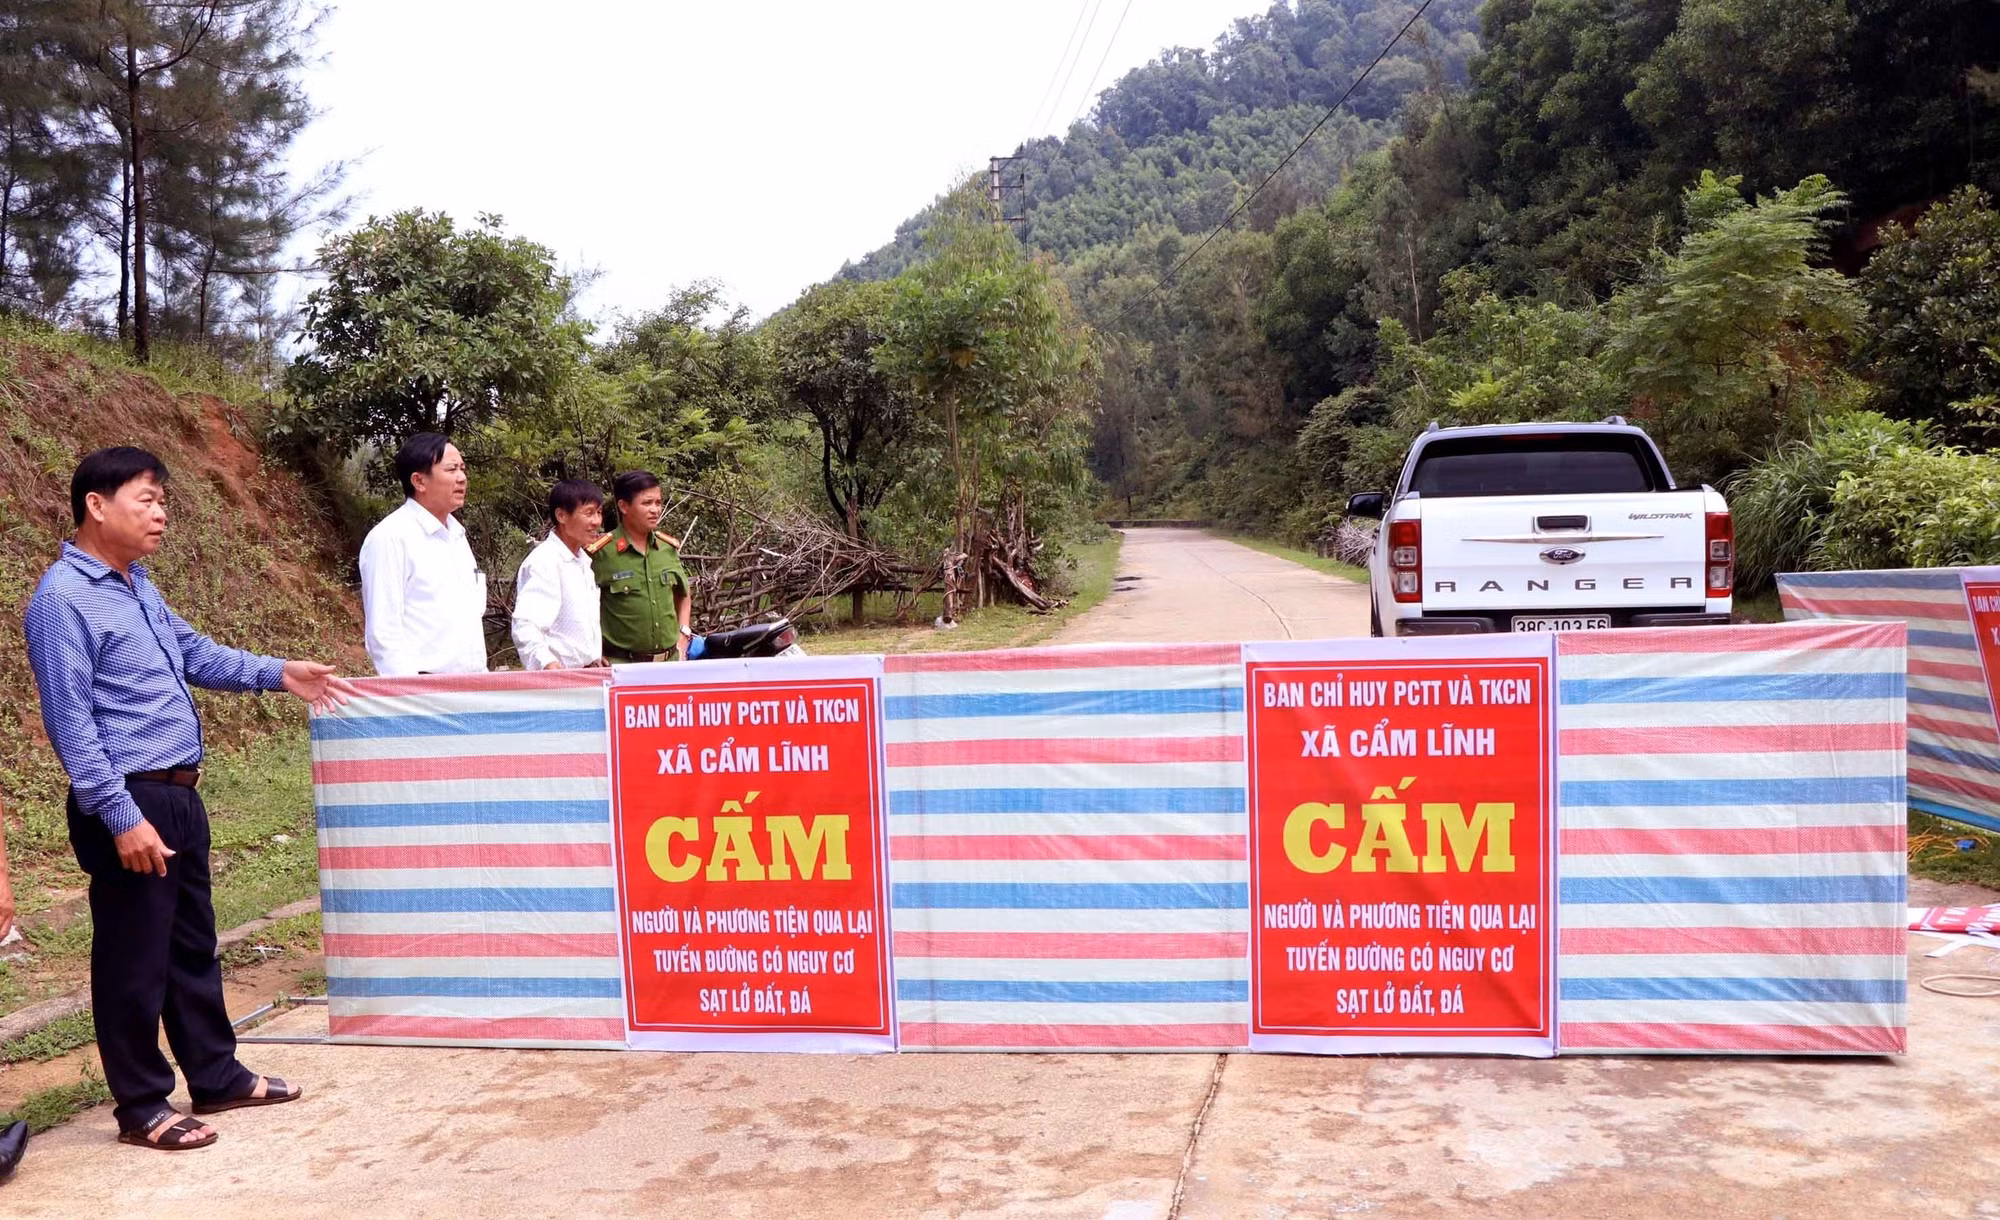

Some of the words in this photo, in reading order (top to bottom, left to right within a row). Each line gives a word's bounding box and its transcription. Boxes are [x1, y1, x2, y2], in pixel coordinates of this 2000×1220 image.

[1628, 512, 1693, 520] WILDTRAK
[1434, 577, 1693, 593] RANGER
[1263, 681, 1305, 708] BAN
[1310, 672, 1344, 708] CHỈ
[1349, 680, 1388, 707] HUY
[1393, 679, 1443, 706] PCTT
[1447, 674, 1474, 705] VÀ
[1478, 678, 1531, 705] TKCN
[624, 704, 660, 729] BAN
[664, 695, 694, 728] CHỈ
[698, 702, 732, 726] HUY
[737, 700, 781, 725] PCTT
[785, 694, 809, 724] VÀ
[812, 698, 860, 724] TKCN
[657, 743, 693, 775] XÃ
[700, 736, 760, 774] CẨM
[768, 740, 829, 772] LĨNH
[1300, 724, 1342, 758] XÃ
[1349, 717, 1417, 758] CẨM
[1427, 723, 1495, 757] LĨNH
[644, 790, 853, 883] CẤM
[1282, 776, 1516, 874] CẤM
[631, 905, 680, 934] NGƯỜI
[682, 905, 703, 934] VÀ
[705, 907, 771, 934] PHƯƠNG
[773, 904, 809, 939] TIỆN
[812, 909, 844, 937] QUA
[847, 910, 872, 939] LẠI
[1263, 897, 1318, 929] NGƯỜI
[1321, 899, 1345, 929] VÀ
[1349, 901, 1421, 929] PHƯƠNG
[1425, 899, 1465, 934] TIỆN
[1469, 903, 1504, 933] QUA
[1508, 904, 1536, 935] LẠI
[653, 943, 702, 973] TUYẾN
[704, 944, 759, 973] ĐƯỜNG
[762, 945, 783, 974] CÓ
[787, 950, 829, 975] NGUY
[832, 948, 855, 975] CƠ
[1285, 938, 1341, 972] TUYẾN
[1345, 941, 1405, 972] ĐƯỜNG
[1410, 941, 1434, 972] CÓ
[1438, 946, 1486, 972] NGUY
[1490, 944, 1515, 973] CƠ
[699, 988, 728, 1017] SẠT
[731, 981, 751, 1013] LỞ
[753, 981, 786, 1017] ĐẤT,
[789, 985, 812, 1014] ĐÁ
[1336, 988, 1369, 1019] SẠT
[1373, 980, 1396, 1014] LỞ
[1399, 980, 1436, 1017] ĐẤT,
[1439, 983, 1465, 1014] ĐÁ
